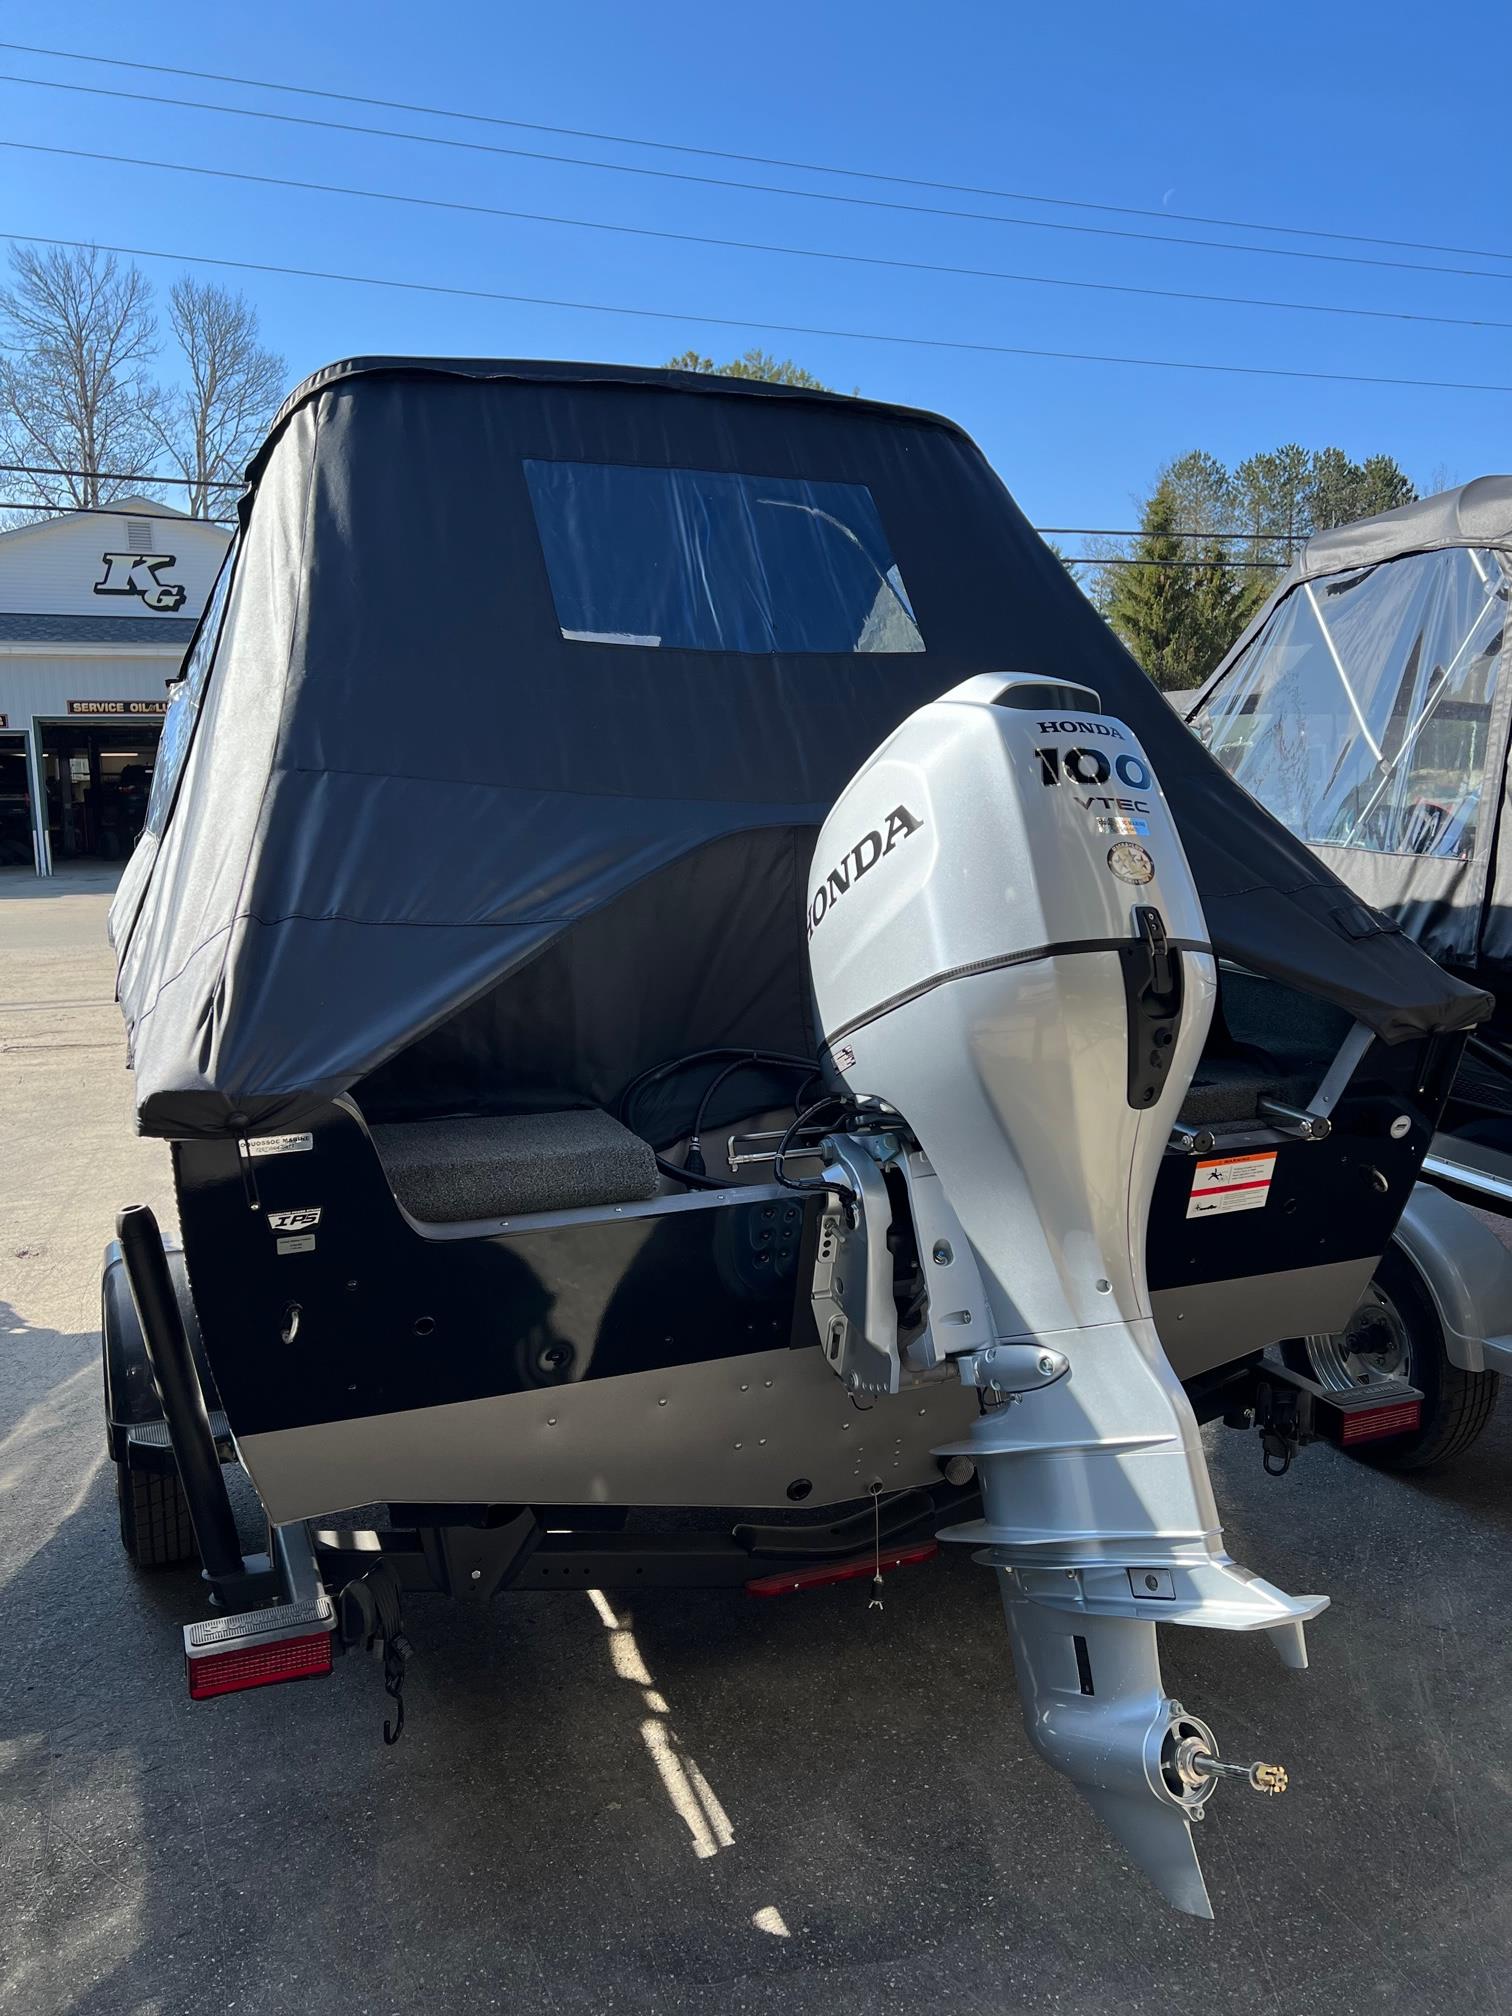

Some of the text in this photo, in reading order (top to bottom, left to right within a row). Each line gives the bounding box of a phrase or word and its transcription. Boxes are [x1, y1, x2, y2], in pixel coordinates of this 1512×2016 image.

[73, 702, 125, 713] SERVICE
[130, 702, 149, 713] OIL
[1036, 720, 1126, 740] HONDA
[1034, 747, 1152, 791] 100
[1073, 796, 1150, 814] VTEC
[240, 1139, 281, 1148] OUOSSOC
[275, 1212, 318, 1227] IPS
